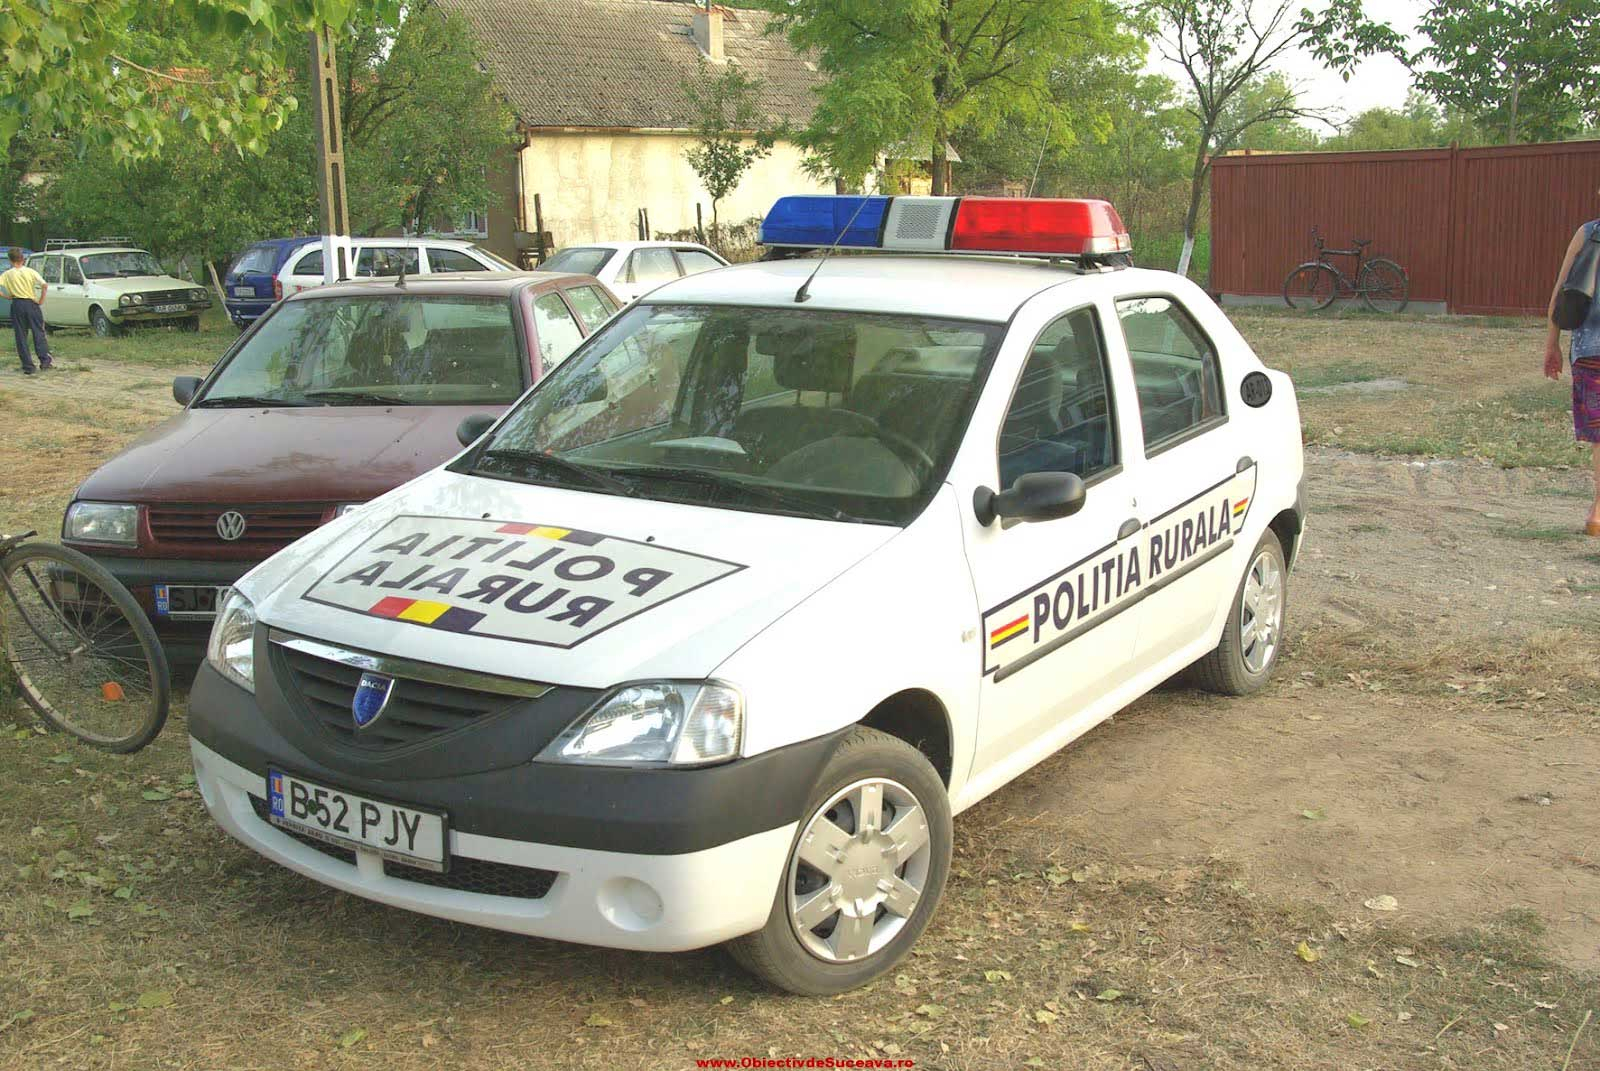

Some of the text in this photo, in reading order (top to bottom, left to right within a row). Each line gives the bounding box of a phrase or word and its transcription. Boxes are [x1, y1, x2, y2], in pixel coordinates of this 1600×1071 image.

[1033, 498, 1230, 644] POLITIA RURALA
[361, 679, 386, 690] DACIA
[272, 796, 284, 812] RO
[290, 781, 310, 819] B
[314, 790, 349, 833] 52
[360, 801, 421, 851] PJY
